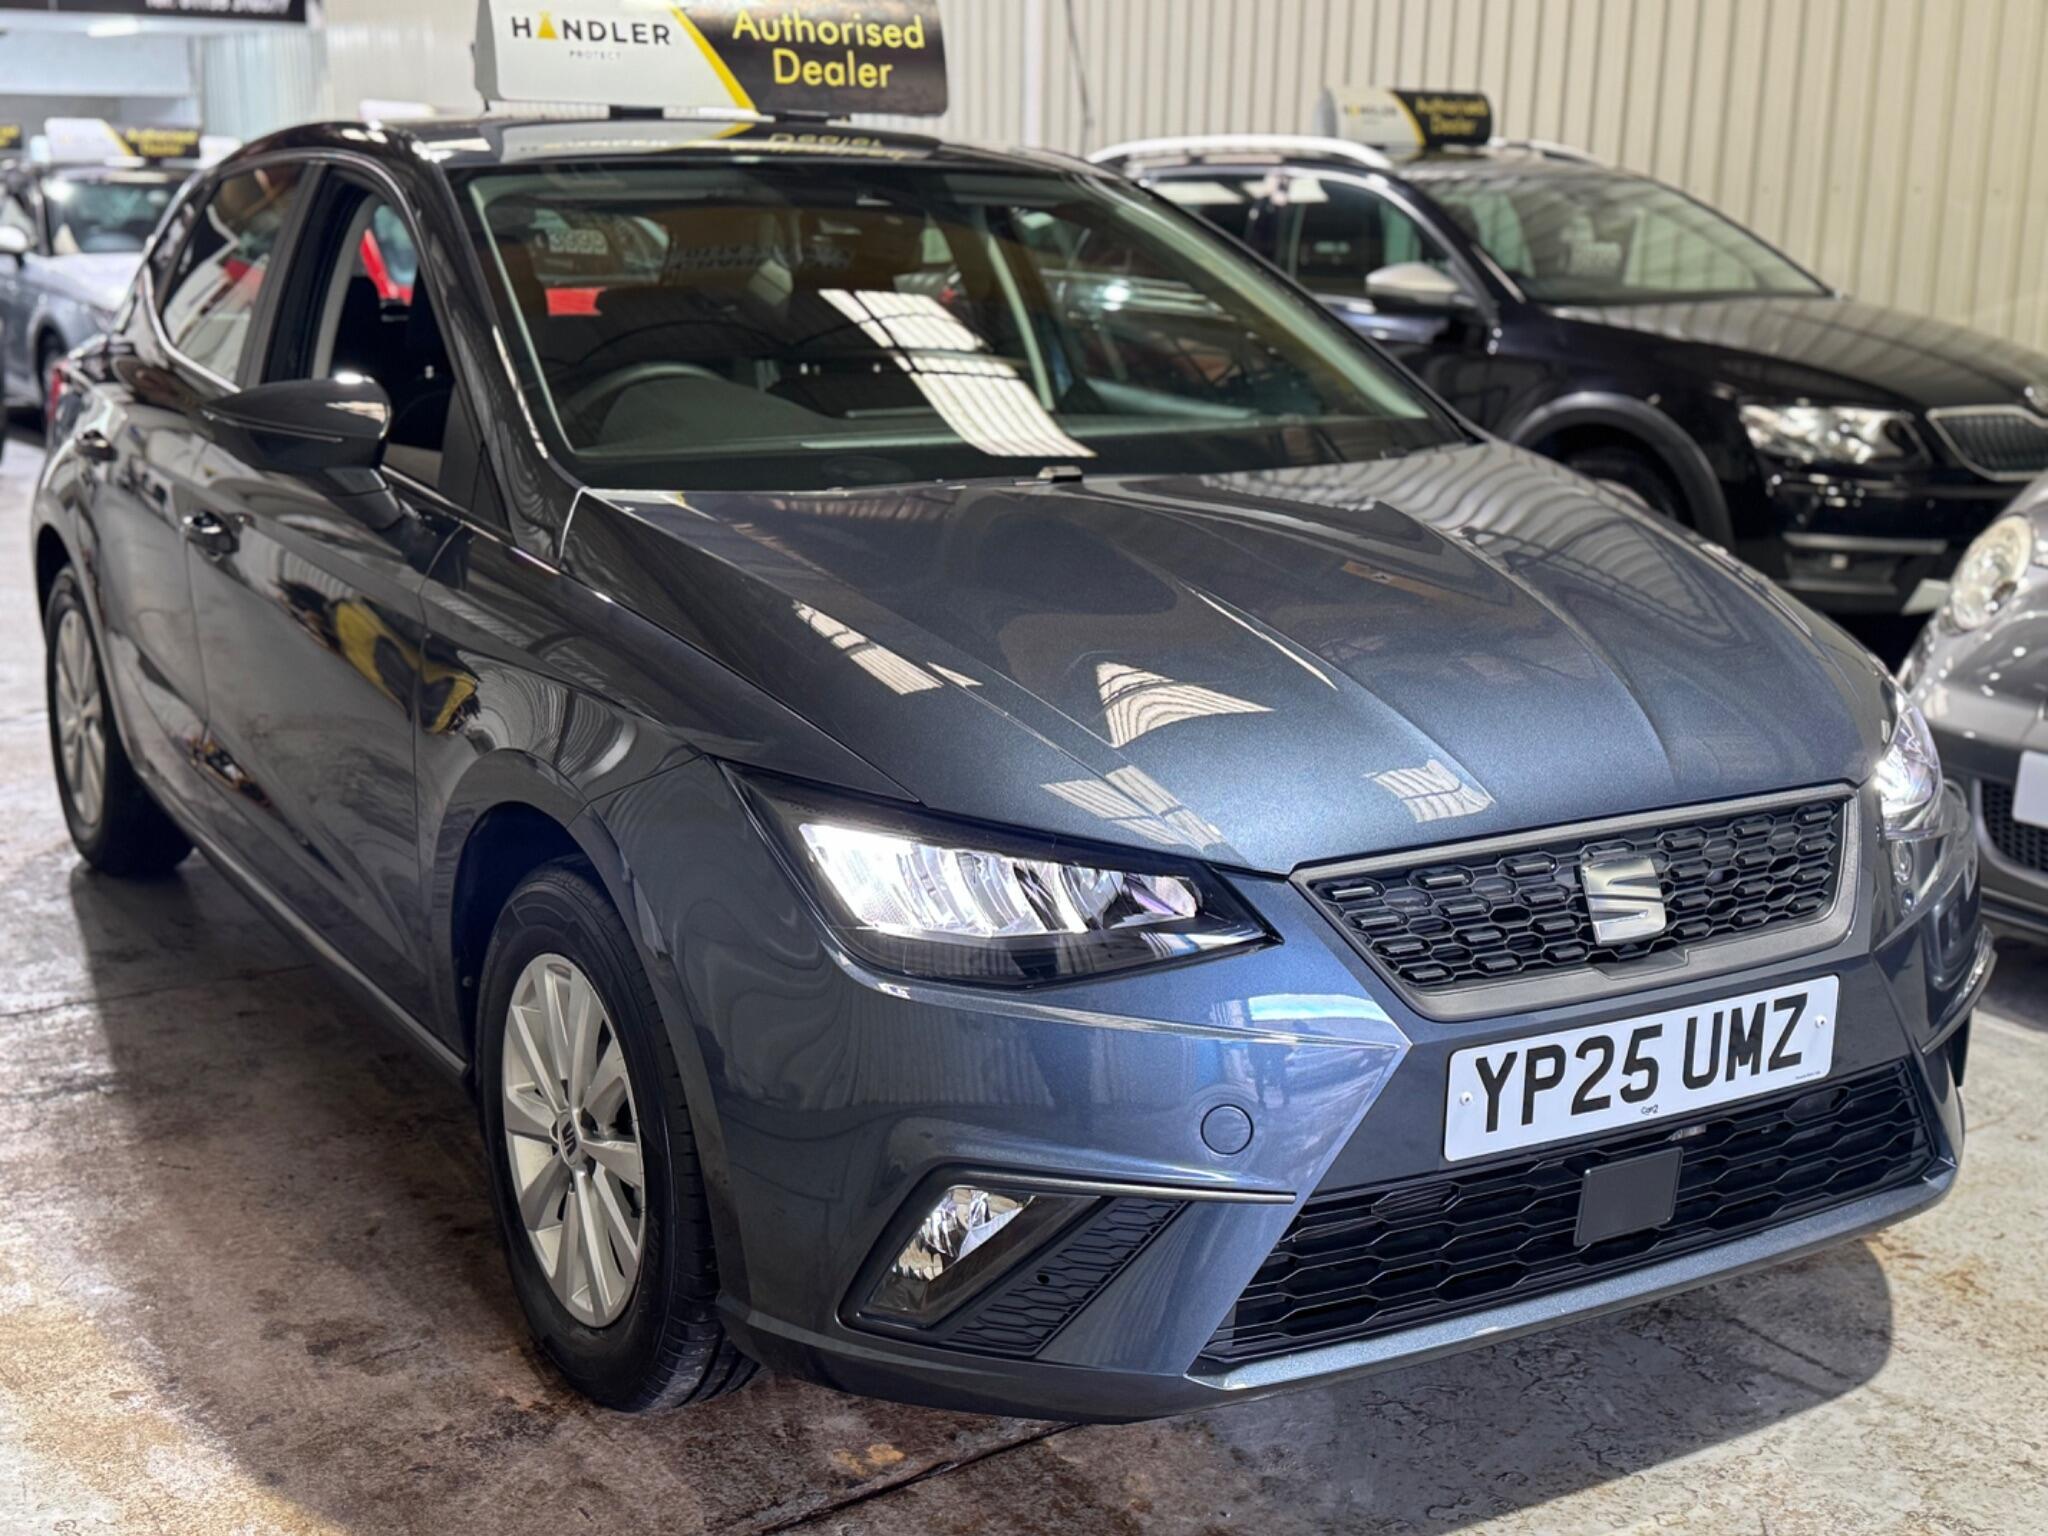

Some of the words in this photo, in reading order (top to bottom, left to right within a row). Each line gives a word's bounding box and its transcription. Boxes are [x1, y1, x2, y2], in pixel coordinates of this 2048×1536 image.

[732, 8, 925, 49] Authorised
[569, 50, 621, 60] PROTECT
[773, 48, 893, 88] Dealer
[1475, 1024, 1663, 1132] YP25
[1682, 992, 1808, 1090] UMZ
